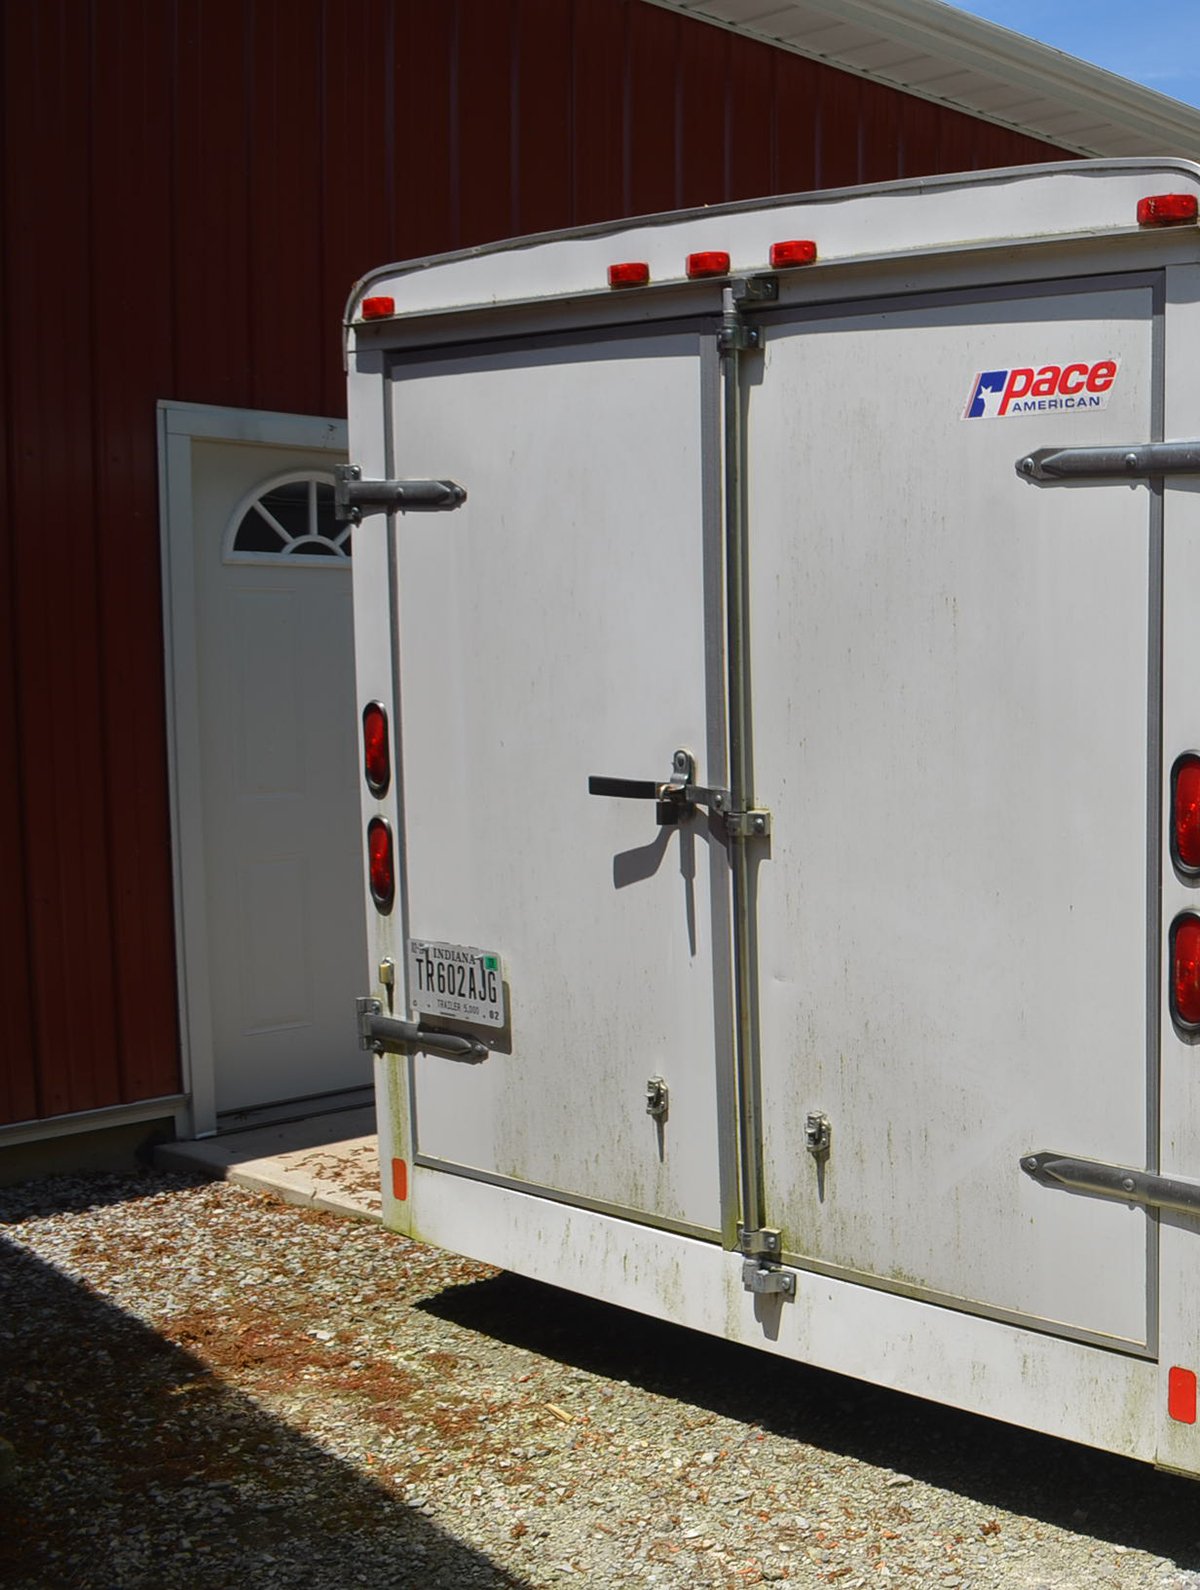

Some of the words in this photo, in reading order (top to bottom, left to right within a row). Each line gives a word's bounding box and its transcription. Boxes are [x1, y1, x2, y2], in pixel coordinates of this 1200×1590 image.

[997, 360, 1117, 416] pace
[1012, 396, 1101, 413] AMERICAN
[433, 947, 476, 965] INDIANA
[415, 958, 497, 1003] TR602AJG
